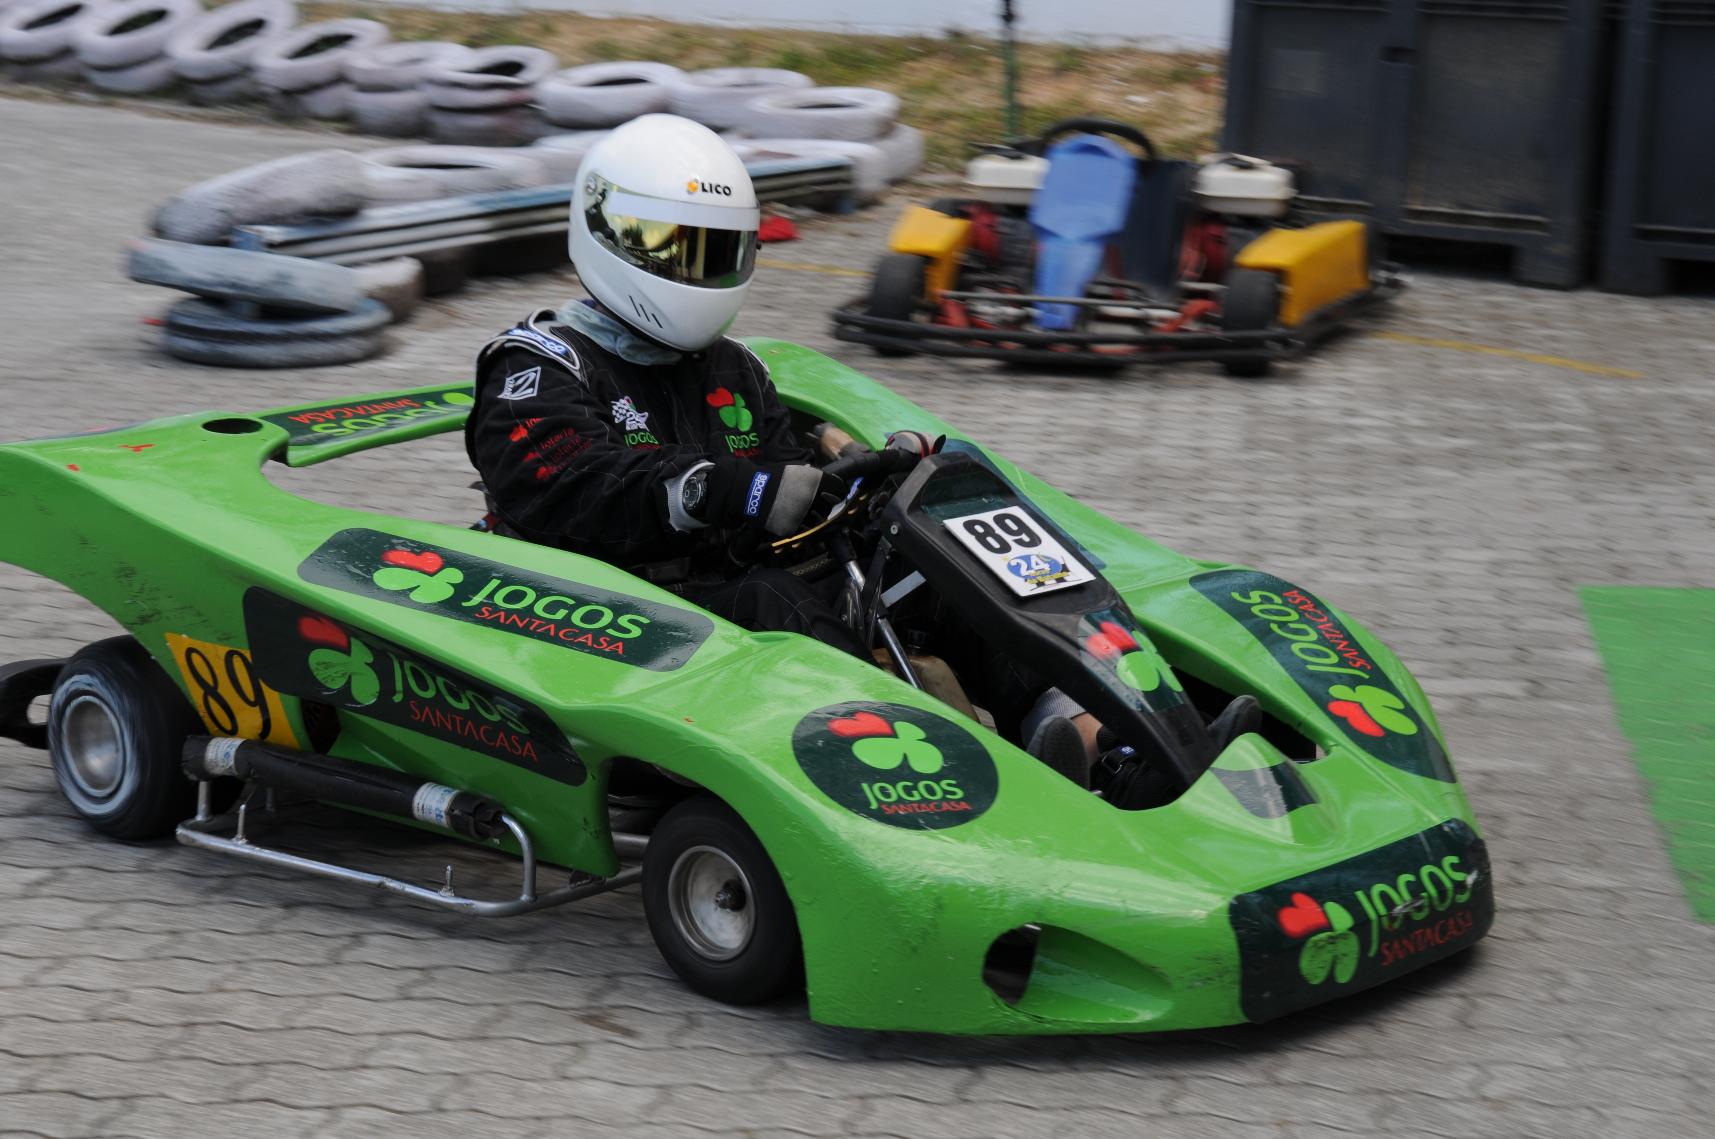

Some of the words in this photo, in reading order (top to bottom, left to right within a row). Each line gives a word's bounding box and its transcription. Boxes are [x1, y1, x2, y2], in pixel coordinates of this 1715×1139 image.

[701, 182, 732, 197] LICO
[725, 432, 760, 453] JOGOS
[747, 473, 769, 514] sparco
[962, 512, 1042, 554] 89
[1007, 554, 1051, 577] 24
[462, 578, 650, 639] JOGOS
[474, 605, 625, 655] SANTACASA
[1282, 588, 1373, 671] SANTACASA
[1231, 590, 1370, 680] JOGOS
[185, 647, 272, 740] 89
[387, 652, 530, 735] JOGOS
[409, 699, 539, 764] SANTACASA
[861, 779, 965, 810] JOGOS
[880, 801, 973, 815] SANTACASA
[1354, 855, 1472, 958] JOGOS
